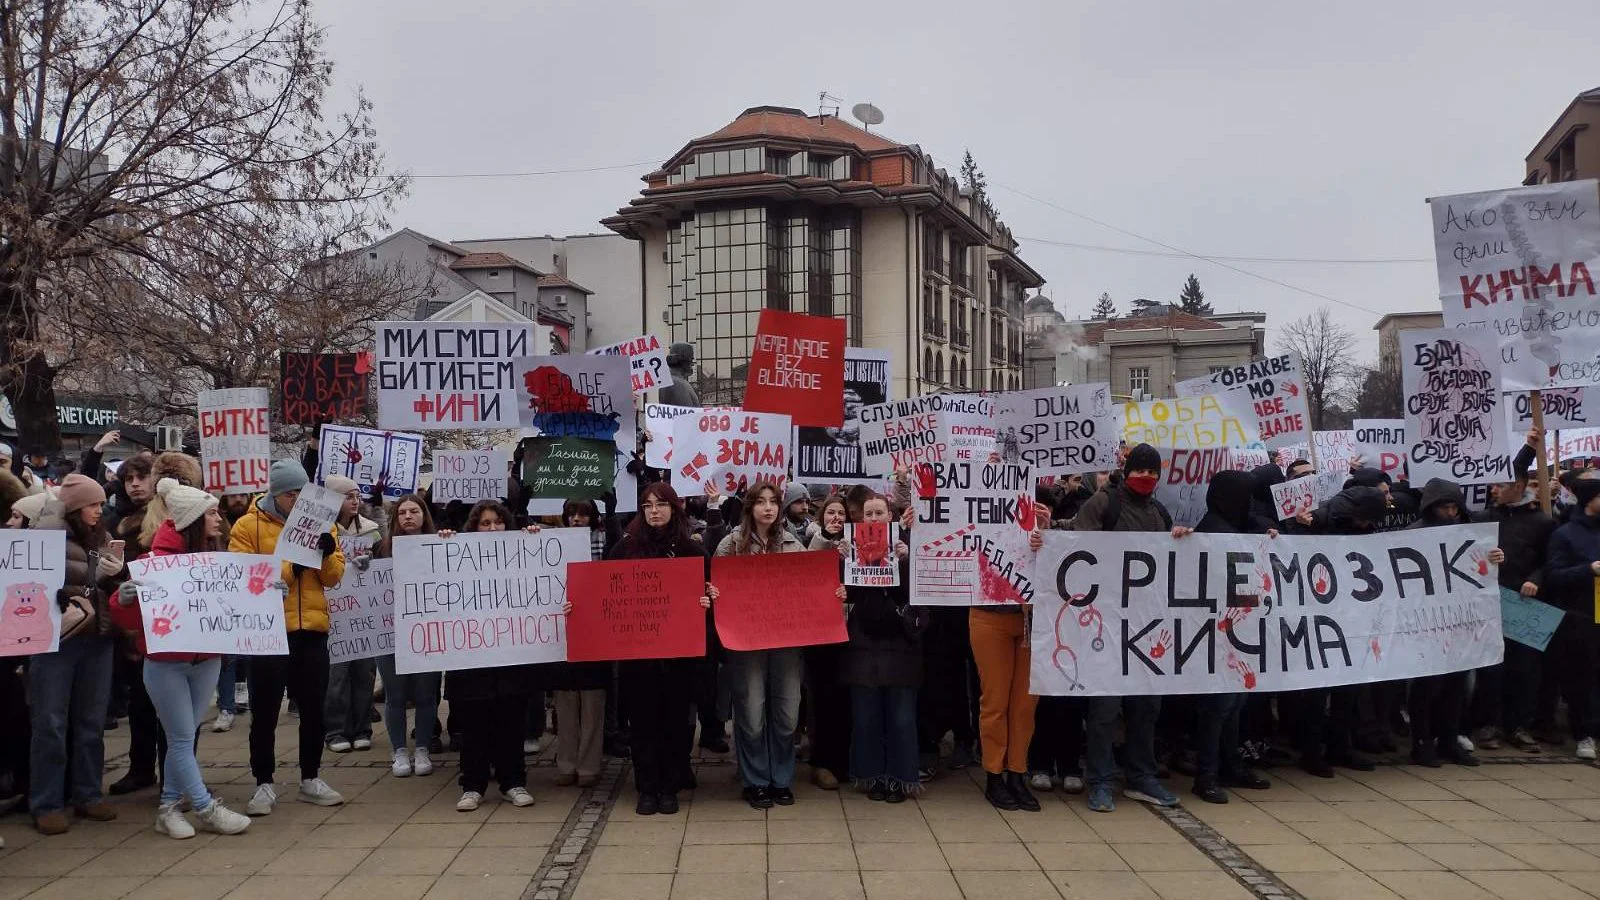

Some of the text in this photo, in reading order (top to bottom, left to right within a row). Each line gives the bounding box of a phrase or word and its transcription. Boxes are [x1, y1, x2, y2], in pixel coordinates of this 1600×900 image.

[1459, 262, 1596, 309] КИЧМА
[384, 328, 527, 357] МИ СМО И
[756, 334, 830, 359] NEMA NADE
[286, 353, 354, 377] РУКЕ
[631, 359, 645, 370] НЕ
[776, 353, 802, 371] BEZ
[284, 377, 307, 400] СУ
[758, 369, 822, 390] BLOKADE
[284, 396, 365, 424] КРВАВЕ
[413, 393, 501, 423] ФИНИ
[860, 395, 942, 424] СЛУШАМО
[1033, 395, 1081, 418] DUM
[200, 407, 269, 438] БИТКЕ
[698, 415, 760, 434] ОВО ЈЕ
[883, 413, 939, 438] БАЈКЕ
[1019, 419, 1095, 444] SPIRO
[716, 439, 785, 469] ЗЕМЉА
[865, 429, 936, 457] ЖИВИМО
[437, 455, 492, 475] ПМФ УЗ
[803, 446, 810, 472] U
[813, 446, 831, 472] IME
[889, 443, 947, 472] ХОРОР
[1020, 444, 1097, 468] SPERO
[206, 459, 268, 492] ДЕЦУ
[434, 477, 503, 499] ПРОСВЕТАРЕ
[725, 472, 748, 492] ЗА
[982, 463, 1030, 491] ФИЛМ
[918, 496, 1036, 525] ЈЕ ТЕШК
[140, 554, 218, 577] УБИЈАТЕ
[420, 538, 562, 573] ТРАЖИМО
[609, 564, 663, 581] we have
[962, 535, 1035, 603] ГЛЕДАТИ
[1269, 540, 1486, 600] МОЗАК
[141, 586, 169, 603] БЕЗ
[181, 580, 240, 594] ОТИСКА
[402, 575, 566, 620] ДЕФИНИЦИЈУ
[610, 581, 662, 595] the best
[188, 598, 208, 613] НА
[601, 596, 670, 611] government
[199, 614, 275, 633] ПИШТОЉУ
[639, 619, 662, 637] buy
[1121, 614, 1353, 677] КИЧМА
